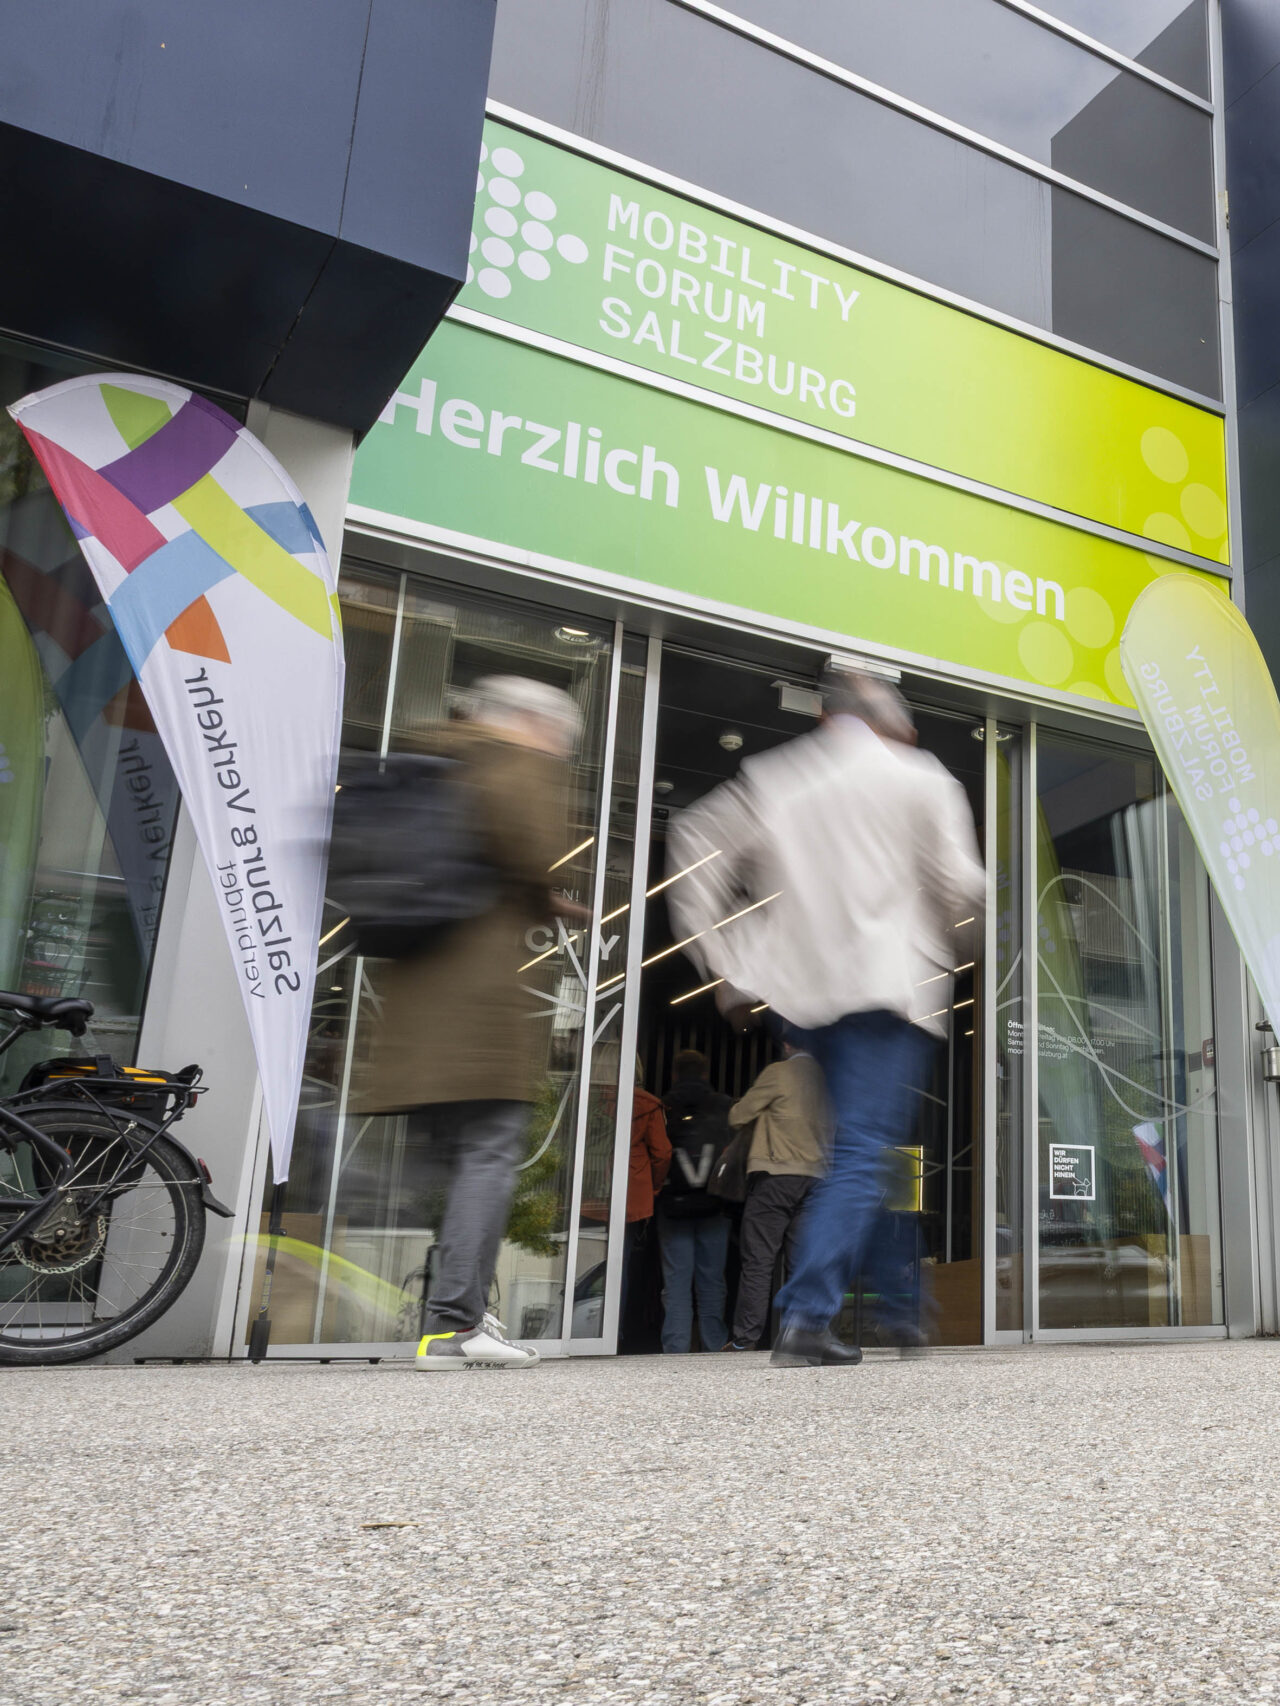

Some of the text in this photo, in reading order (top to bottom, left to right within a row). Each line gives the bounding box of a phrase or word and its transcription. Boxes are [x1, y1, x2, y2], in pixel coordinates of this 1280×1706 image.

[602, 246, 766, 338] FORUM
[607, 193, 861, 322] MOBILITY
[599, 295, 858, 418] SALZBURG
[378, 377, 1067, 621] Herzlich Willkommen
[1054, 1156, 1079, 1164] DÜRFEN
